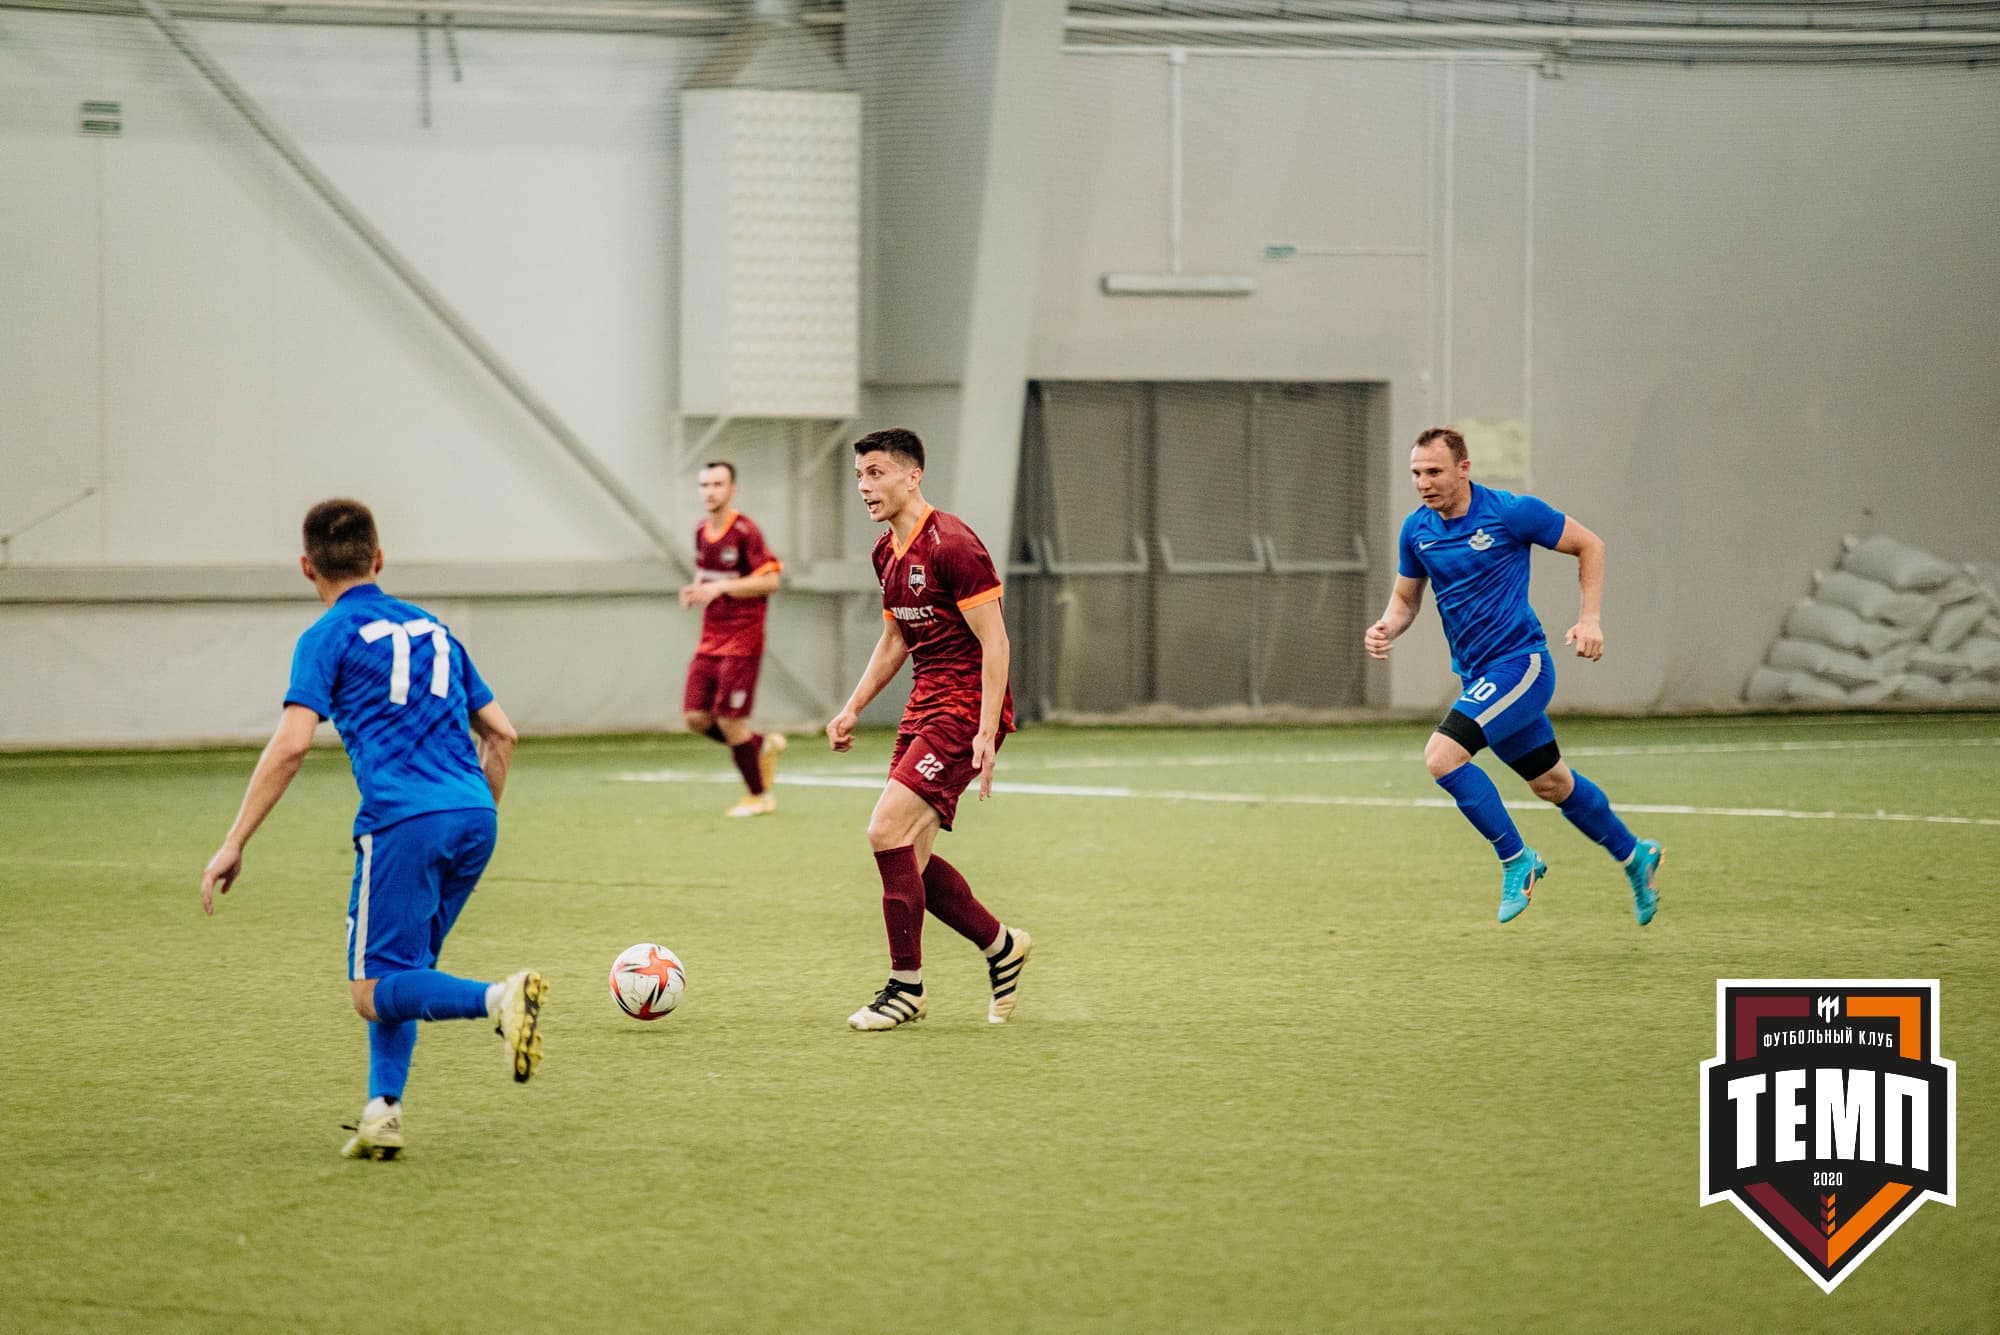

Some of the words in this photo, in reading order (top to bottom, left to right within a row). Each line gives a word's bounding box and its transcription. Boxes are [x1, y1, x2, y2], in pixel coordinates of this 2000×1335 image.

[359, 618, 450, 705] 77
[1467, 676, 1497, 701] 10
[915, 752, 945, 781] 22
